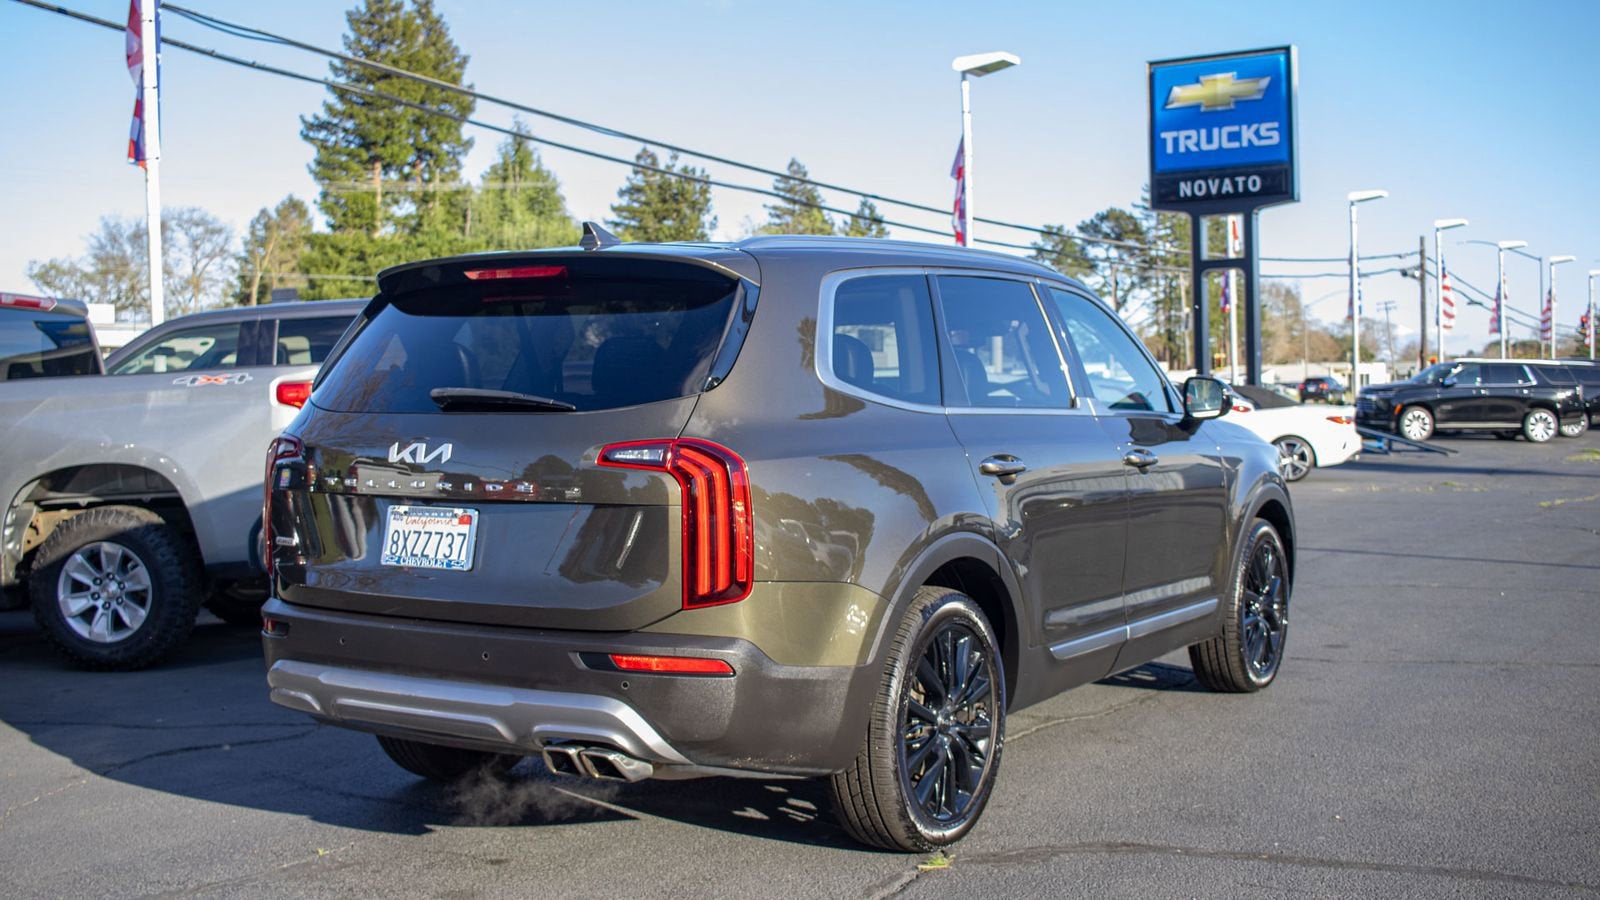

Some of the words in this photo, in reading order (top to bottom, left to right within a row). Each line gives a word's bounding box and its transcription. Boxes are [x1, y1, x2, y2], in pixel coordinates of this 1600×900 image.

[1160, 121, 1280, 154] TRUCKS
[1179, 174, 1262, 198] NOVATO
[406, 516, 453, 529] California
[389, 529, 467, 560] 8XZZ737
[400, 556, 448, 568] CHEVROLET
